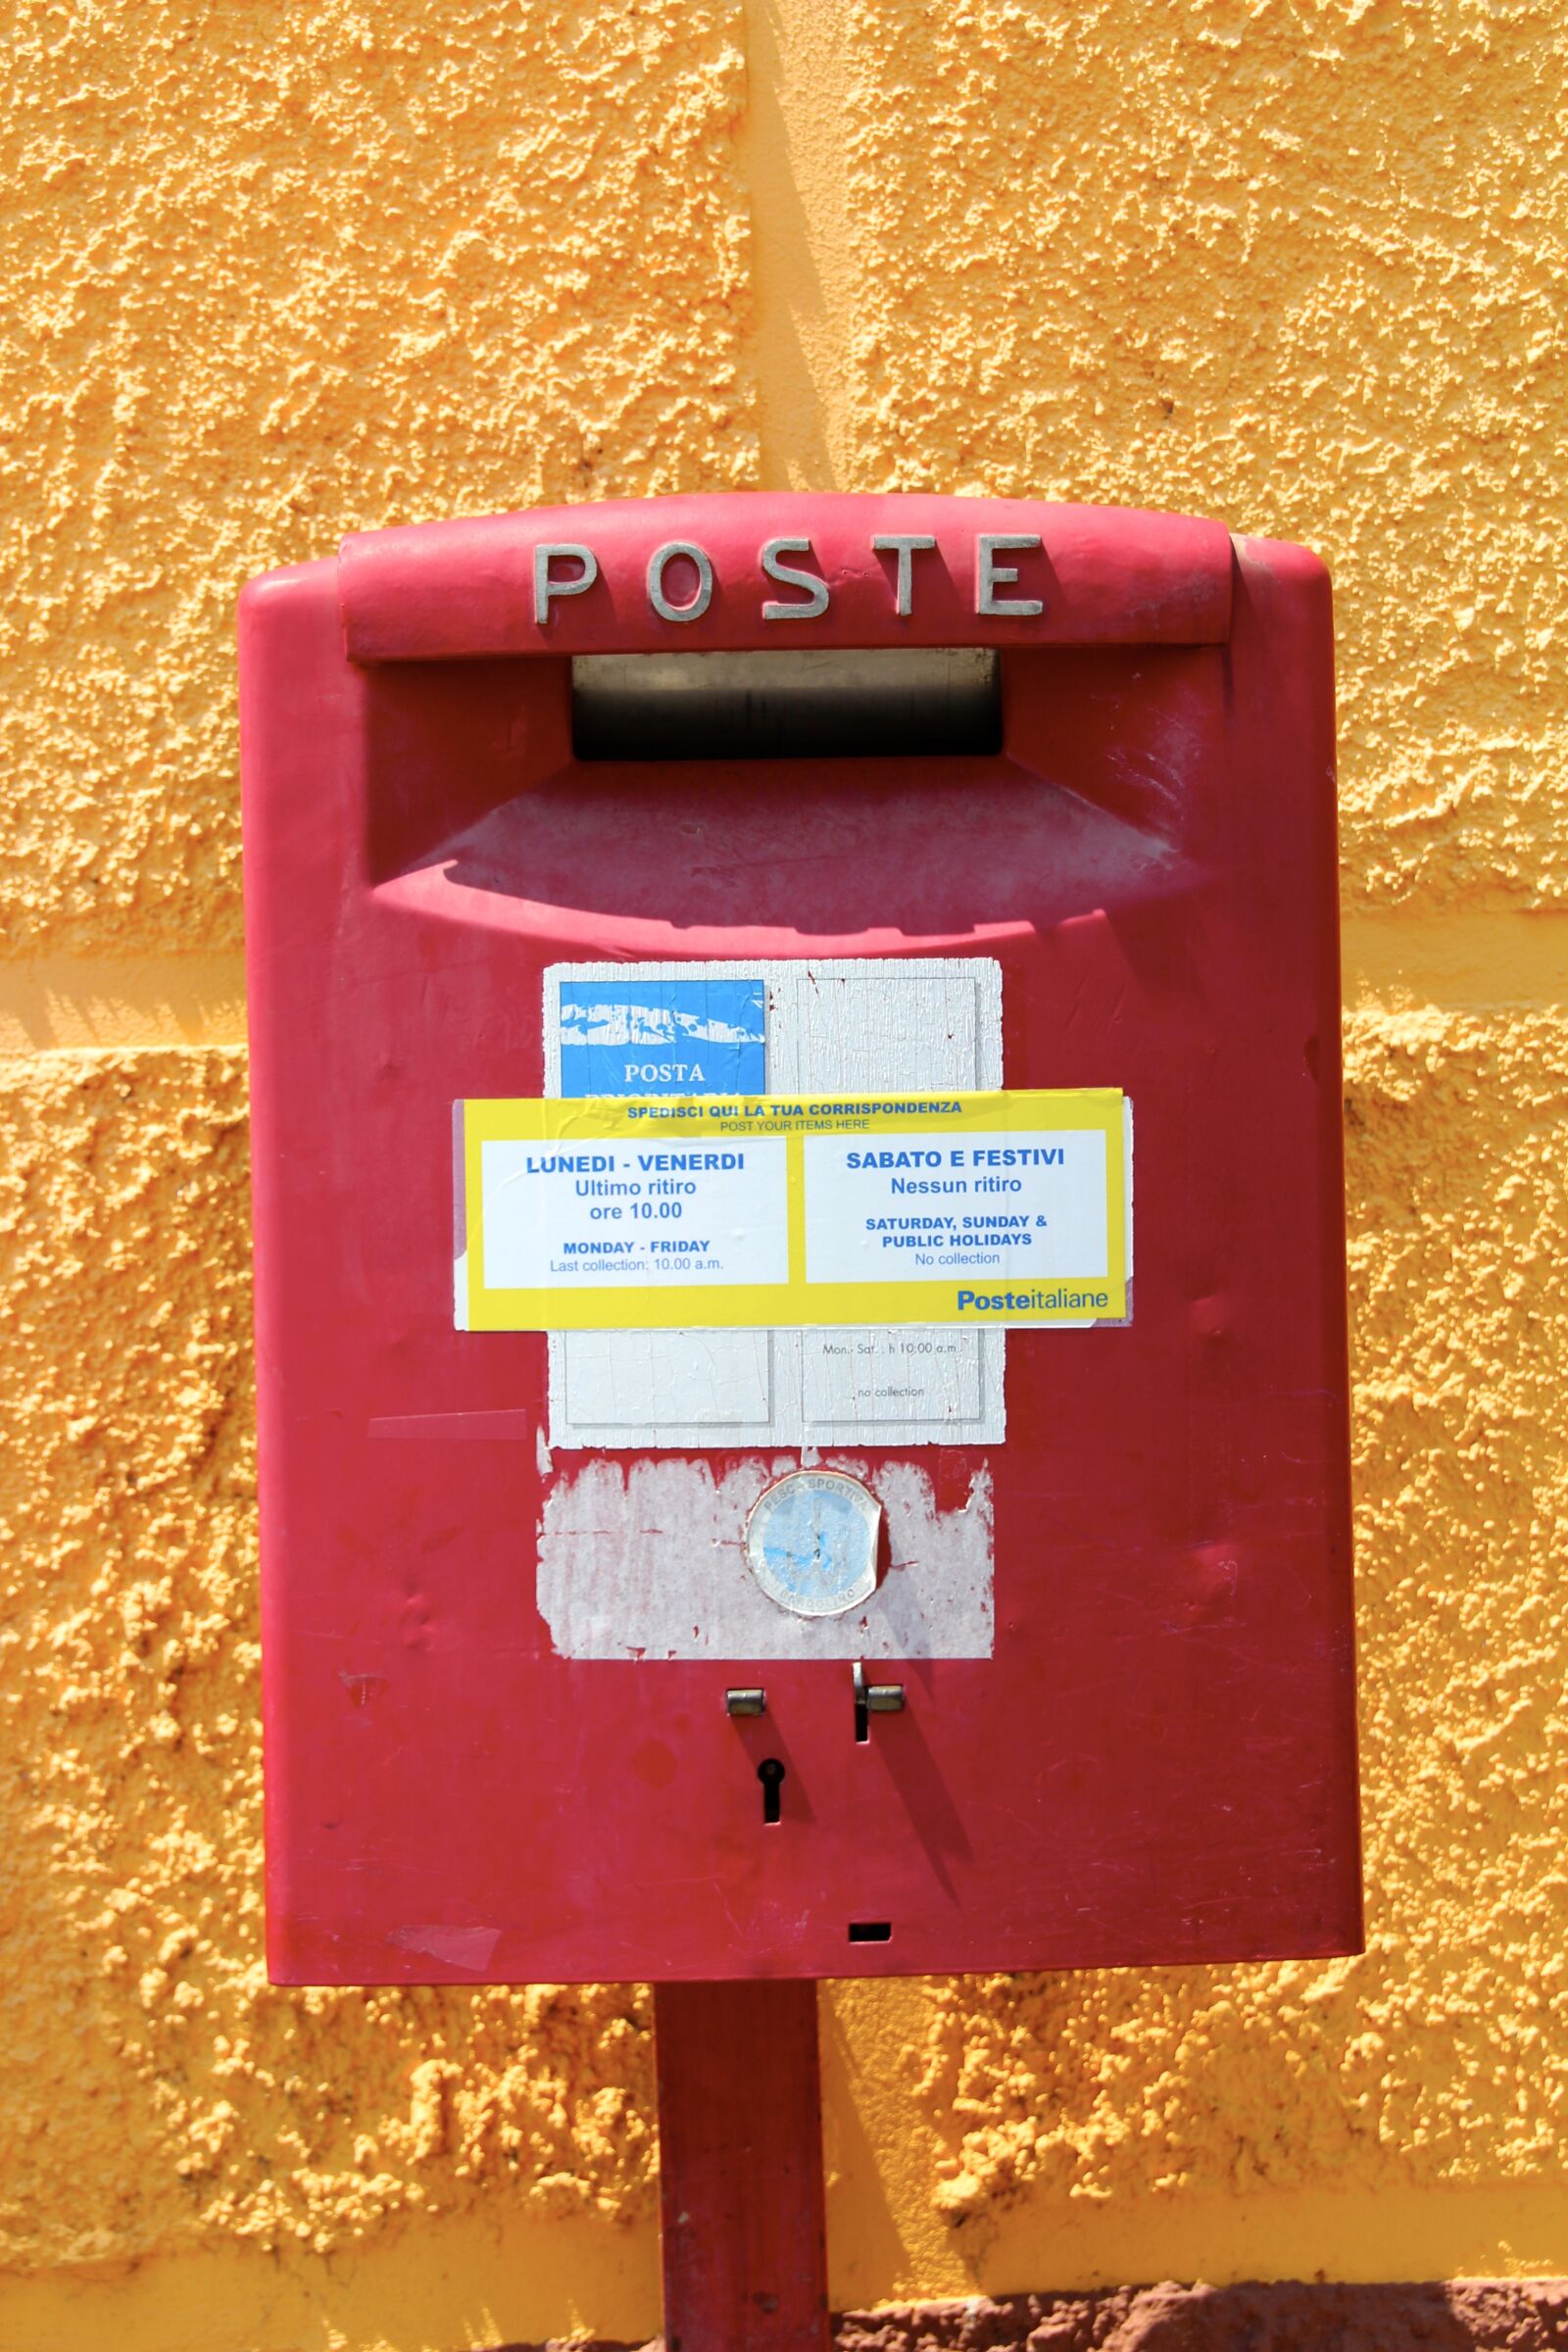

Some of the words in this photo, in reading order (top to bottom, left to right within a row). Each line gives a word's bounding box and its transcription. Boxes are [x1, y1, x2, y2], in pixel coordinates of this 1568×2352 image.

[534, 534, 1044, 625] POSTE
[623, 1063, 706, 1083] POSTA
[627, 1106, 704, 1119] SPEDISCI
[709, 1105, 739, 1119] QUI
[744, 1105, 765, 1117] LA
[770, 1103, 805, 1117] TUA
[808, 1102, 962, 1115] CORRISPONDENZA
[719, 1120, 753, 1132] POST
[756, 1119, 793, 1131] YOUR
[795, 1119, 832, 1130] ITEMS
[836, 1118, 870, 1129] HERE
[526, 1155, 615, 1174] LUNEDI
[637, 1153, 745, 1171] VENERDI
[846, 1151, 943, 1169] SABATO
[950, 1151, 965, 1167] E
[972, 1148, 1065, 1166] FESTIVI
[575, 1179, 642, 1196] Ultimo
[648, 1178, 697, 1195] ritiro
[890, 1177, 967, 1194] Nessun
[973, 1175, 1022, 1193] ritiro
[589, 1206, 622, 1219] ore
[629, 1201, 682, 1219] 10.00
[865, 1216, 957, 1231] SATURDAY,
[961, 1215, 1030, 1229] SUNDAY
[1035, 1214, 1048, 1227] &
[563, 1242, 635, 1255] MONDAY
[650, 1240, 710, 1253] FRIDAY
[881, 1234, 945, 1249] PUBLIC
[949, 1232, 1033, 1248] HOLIDAYS
[550, 1260, 579, 1272] Last
[582, 1258, 650, 1272] collection:
[655, 1258, 691, 1270] 10.00
[694, 1260, 724, 1270] a.m.
[914, 1253, 935, 1265] No
[937, 1251, 1001, 1264] collection
[956, 1288, 1109, 1311] Posteitaliane
[874, 1387, 924, 1396] collection
[763, 1484, 806, 1512] PESC
